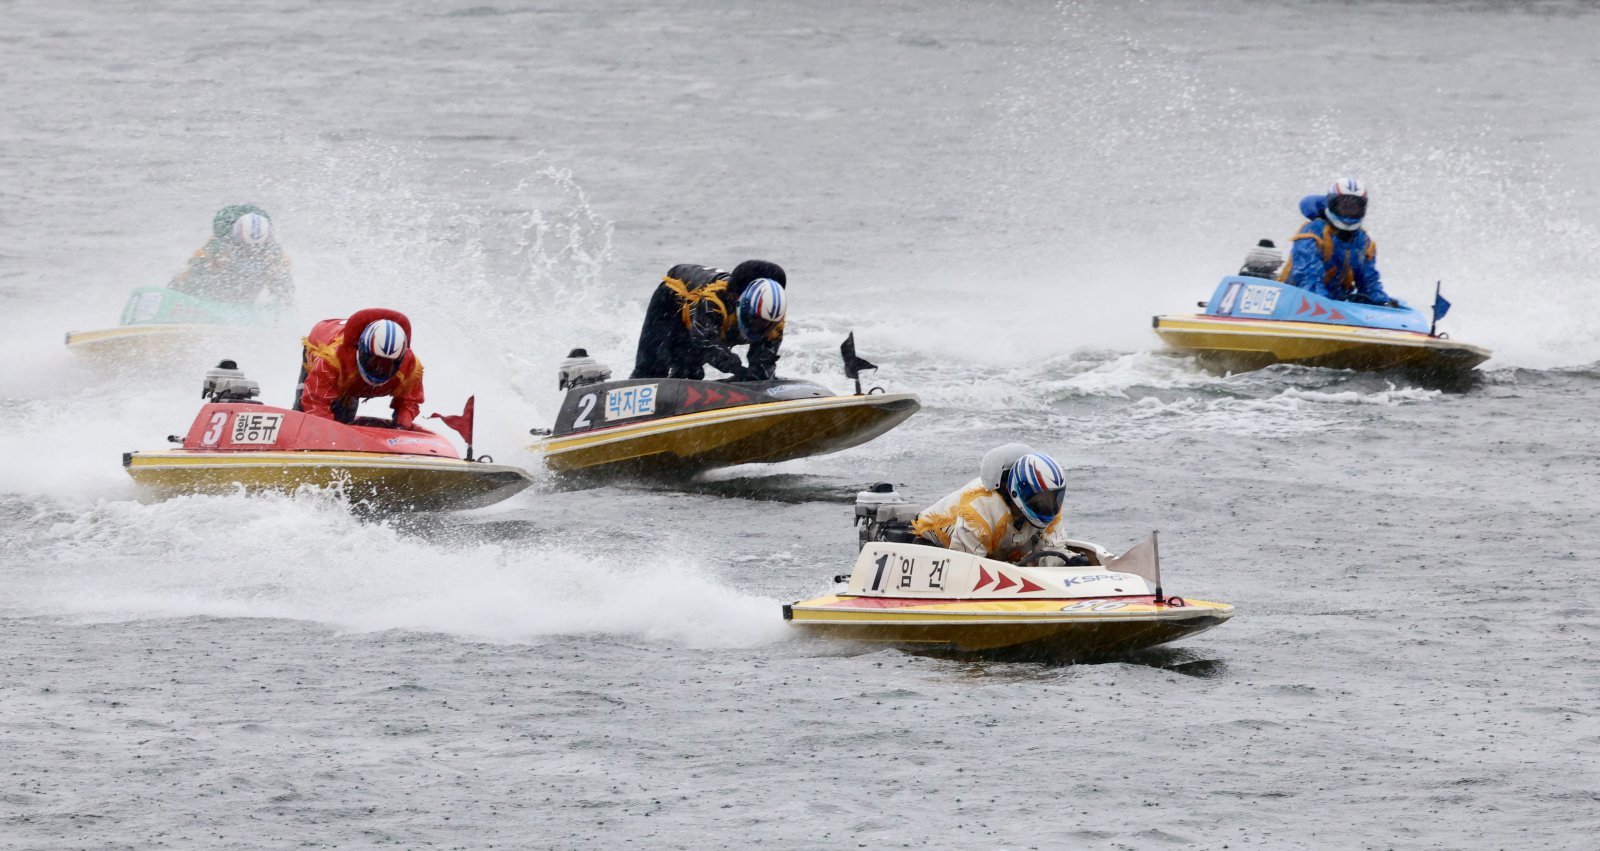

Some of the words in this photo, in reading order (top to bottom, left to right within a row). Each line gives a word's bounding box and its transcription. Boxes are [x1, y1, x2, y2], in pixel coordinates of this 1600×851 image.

[1219, 283, 1241, 313] 4
[572, 393, 597, 428] 2
[609, 387, 652, 416] 박지윤
[203, 412, 227, 445] 3
[235, 415, 278, 441] 황동규
[871, 554, 889, 590] 1
[901, 558, 915, 587] 임
[928, 560, 945, 588] 건
